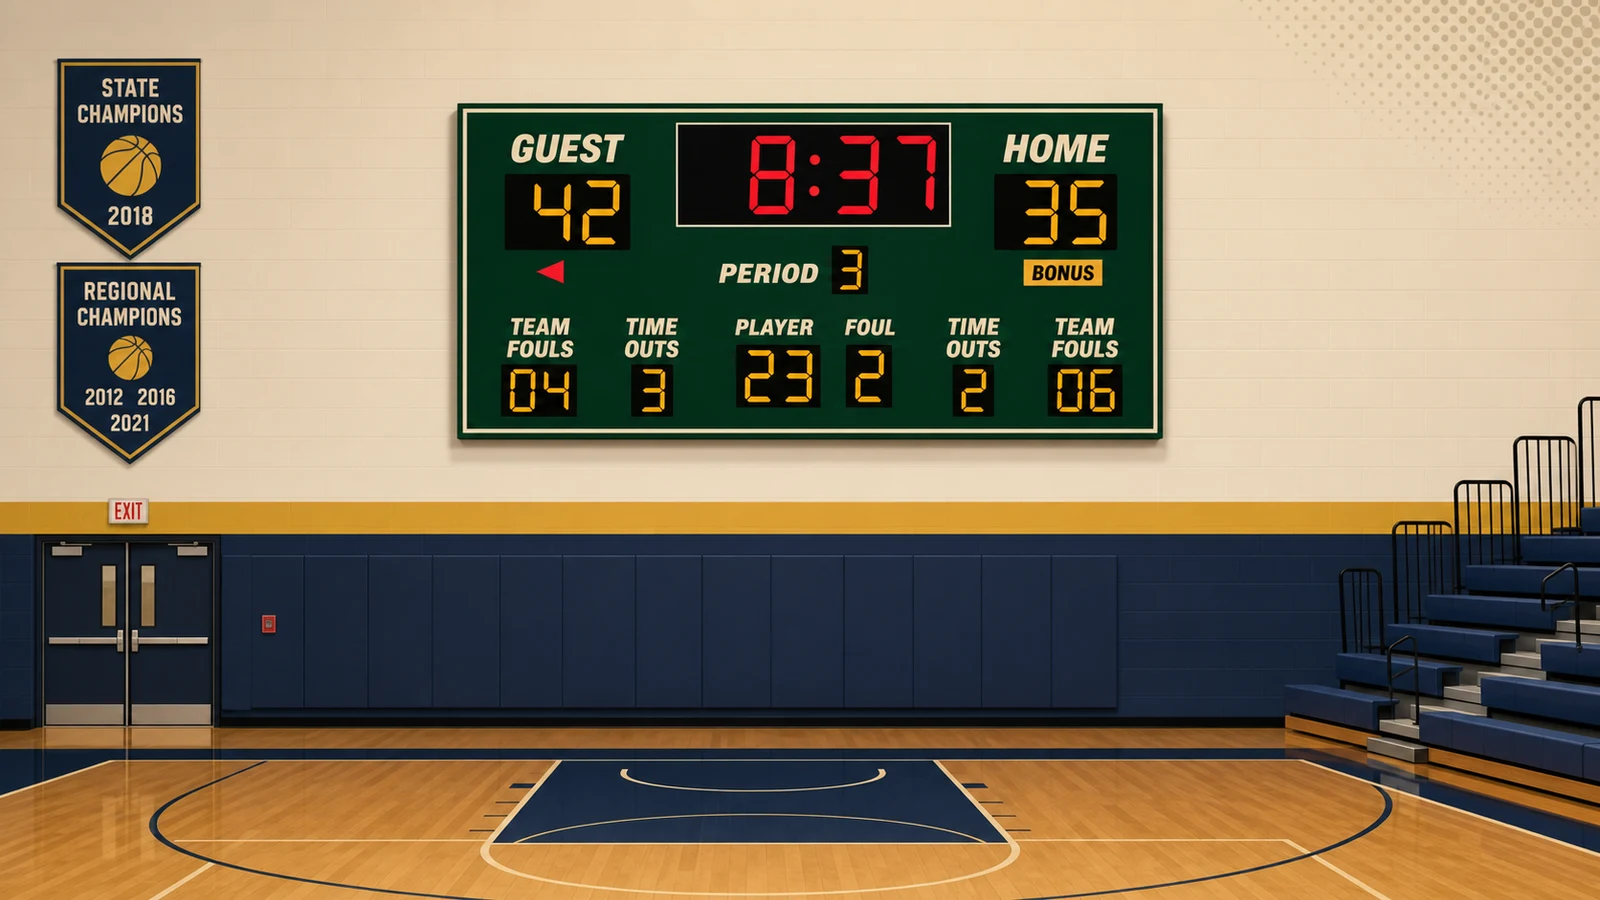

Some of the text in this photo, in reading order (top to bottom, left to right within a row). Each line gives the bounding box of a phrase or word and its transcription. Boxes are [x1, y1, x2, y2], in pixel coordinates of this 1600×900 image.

[102, 78, 159, 97] STATE
[78, 105, 182, 123] CHAMPIONS
[511, 134, 625, 163] GUEST
[1003, 134, 1109, 163] HOME
[749, 136, 936, 214] 8:37
[109, 206, 152, 225] 2018
[534, 180, 620, 244] 42
[1024, 180, 1106, 244] 35
[719, 263, 818, 283] PERIOD
[840, 250, 862, 290] 3
[1032, 265, 1094, 280] BONUS
[85, 282, 175, 300] REGIONAL
[78, 308, 181, 326] CHAMPIONS
[511, 318, 570, 335] TEAM
[627, 318, 678, 335] TIME
[735, 319, 813, 335] PLAYER
[845, 319, 895, 336] FOUL
[948, 318, 1000, 335] TIME
[1056, 318, 1114, 335] TEAM
[507, 340, 574, 358] FOULS
[625, 340, 679, 358] OUTS
[947, 340, 1001, 358] OUTS
[1052, 340, 1118, 358] FOULS
[745, 350, 812, 402] 23
[855, 350, 884, 402] 2
[86, 388, 175, 405] 2012 2016
[510, 369, 569, 412] 04
[642, 369, 665, 412] 3
[961, 369, 986, 412] 2
[1057, 369, 1115, 412] 06
[111, 414, 148, 431] 2021
[114, 502, 142, 520] EXIT
